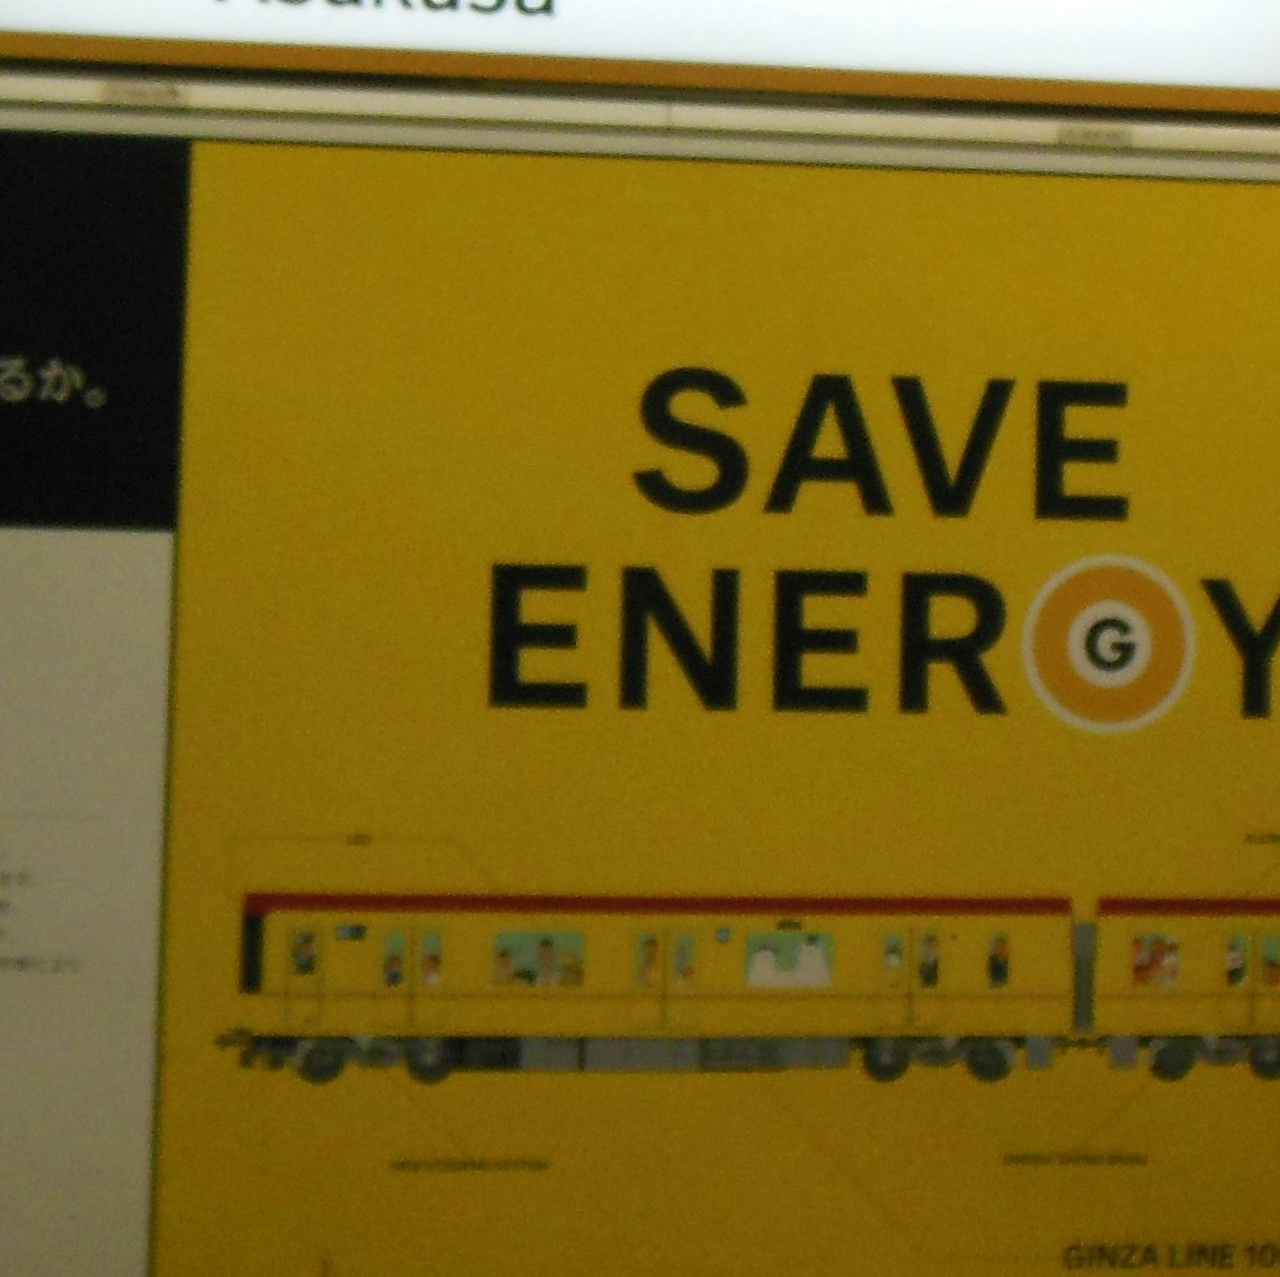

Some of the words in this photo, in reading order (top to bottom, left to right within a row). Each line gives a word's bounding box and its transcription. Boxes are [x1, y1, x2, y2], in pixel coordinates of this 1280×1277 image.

[632, 365, 1131, 522] SAVE
[1063, 1242, 1158, 1271] GINZA
[1169, 1243, 1236, 1270] LINE
